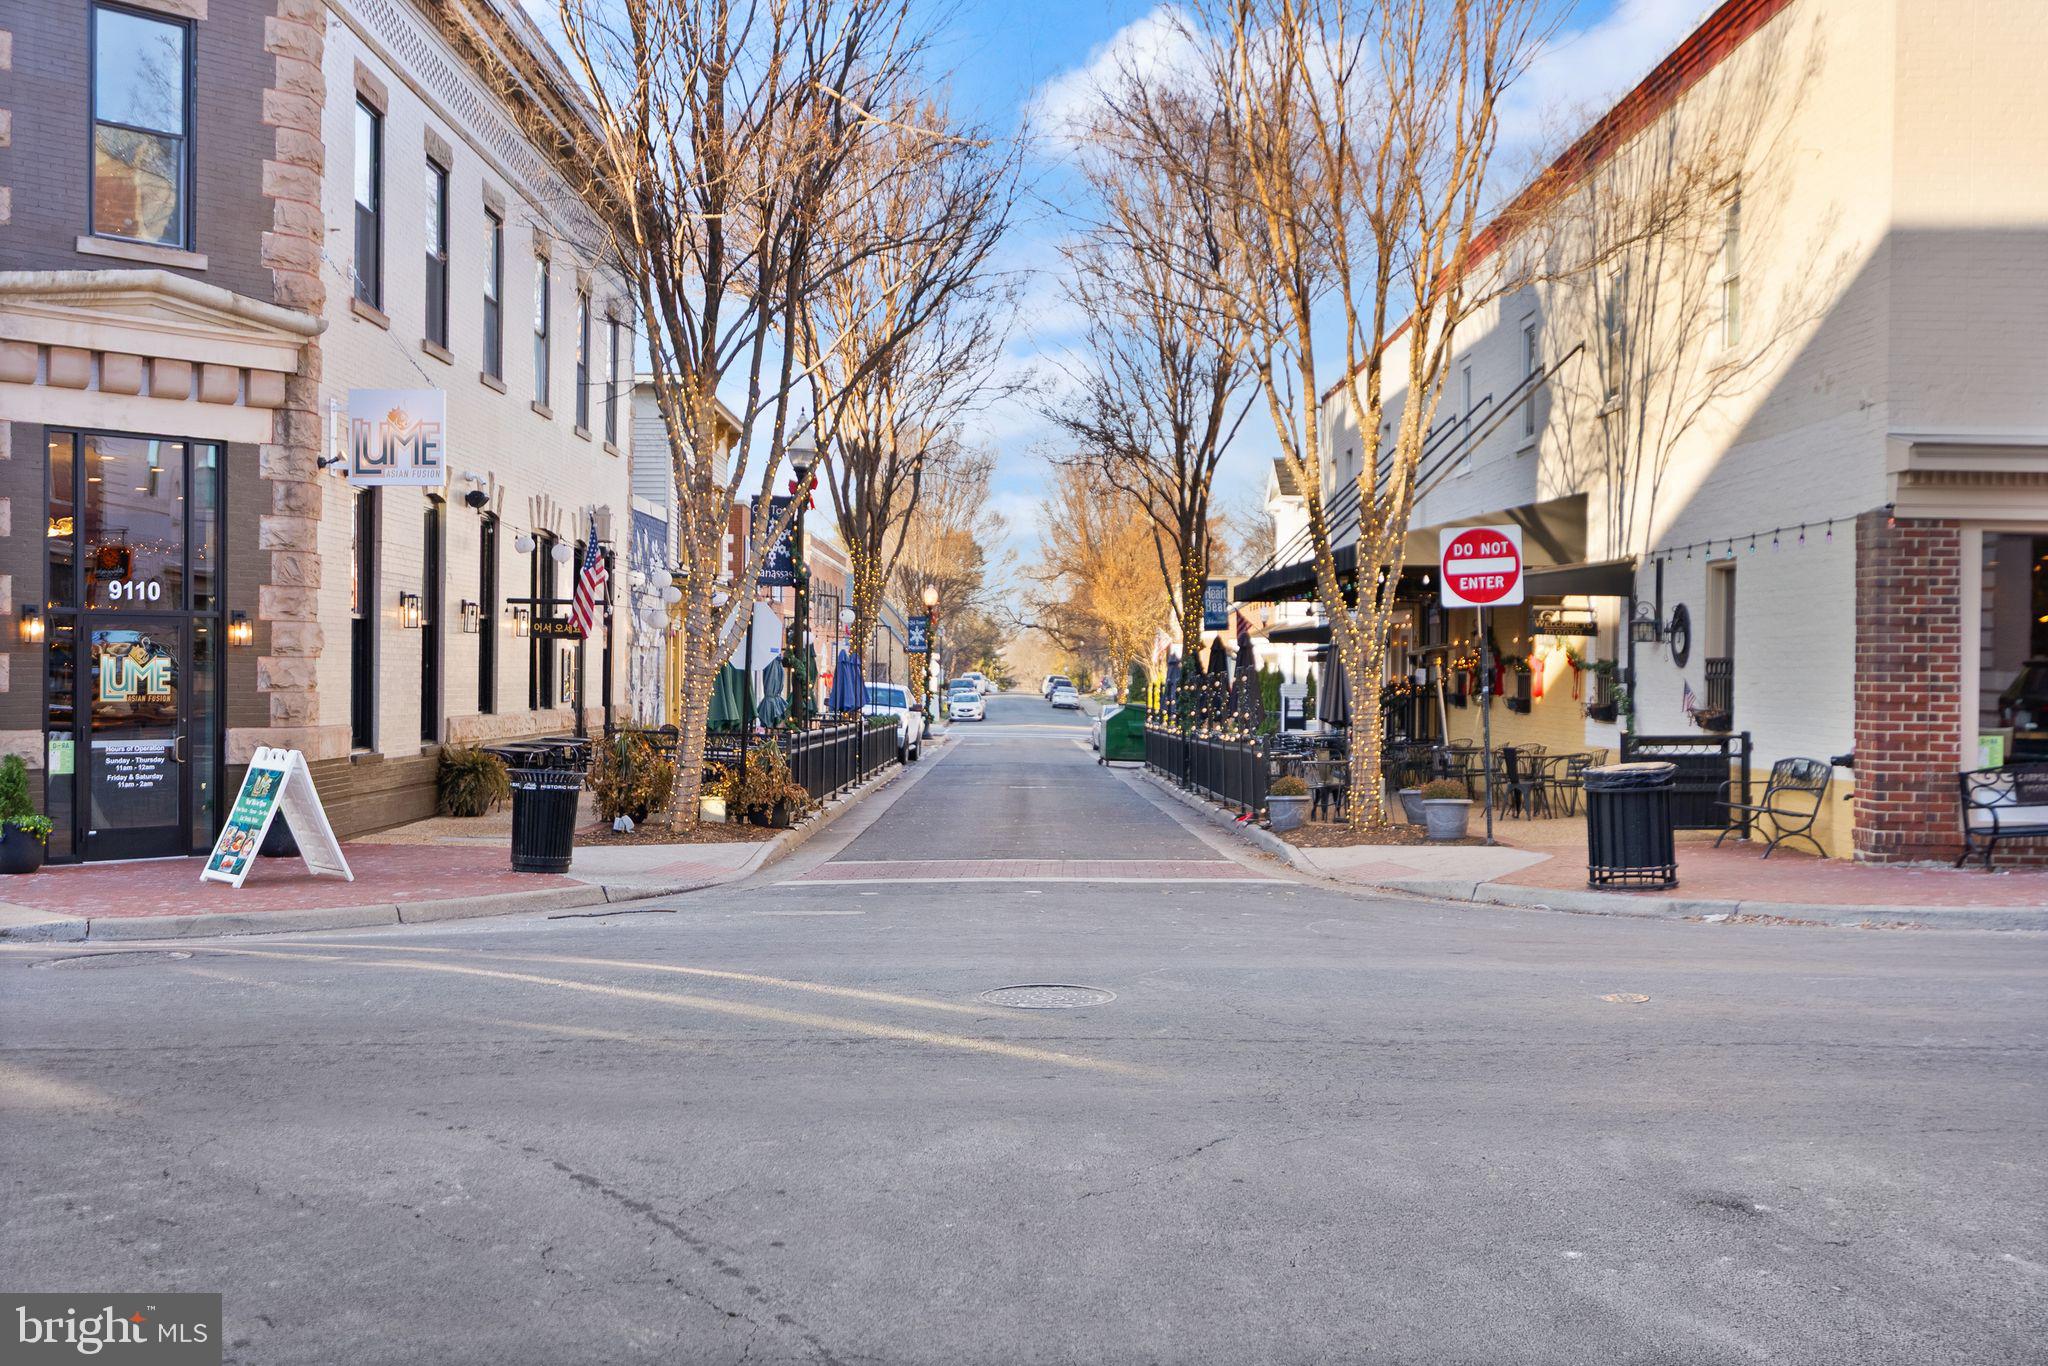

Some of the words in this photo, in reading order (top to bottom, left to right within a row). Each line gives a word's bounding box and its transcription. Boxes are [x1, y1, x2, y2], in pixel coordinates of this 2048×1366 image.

[352, 418, 440, 478] LUME
[386, 470, 409, 478] ASIAN
[412, 470, 440, 478] FUSION
[1453, 543, 1474, 557] DO
[1481, 541, 1509, 556] NOT
[760, 568, 793, 578] anassas
[1460, 576, 1505, 591] ENTER
[109, 580, 160, 601] 9110
[1205, 600, 1227, 612] Beat
[534, 623, 552, 633] 어서
[100, 653, 172, 702] LUME
[105, 745, 126, 753] Hours
[134, 745, 165, 753] Operation
[105, 757, 131, 765] Sunday
[135, 756, 165, 764] Thursday
[107, 774, 128, 782] Friday
[135, 773, 164, 781] Saturday
[139, 780, 154, 788] 2am
